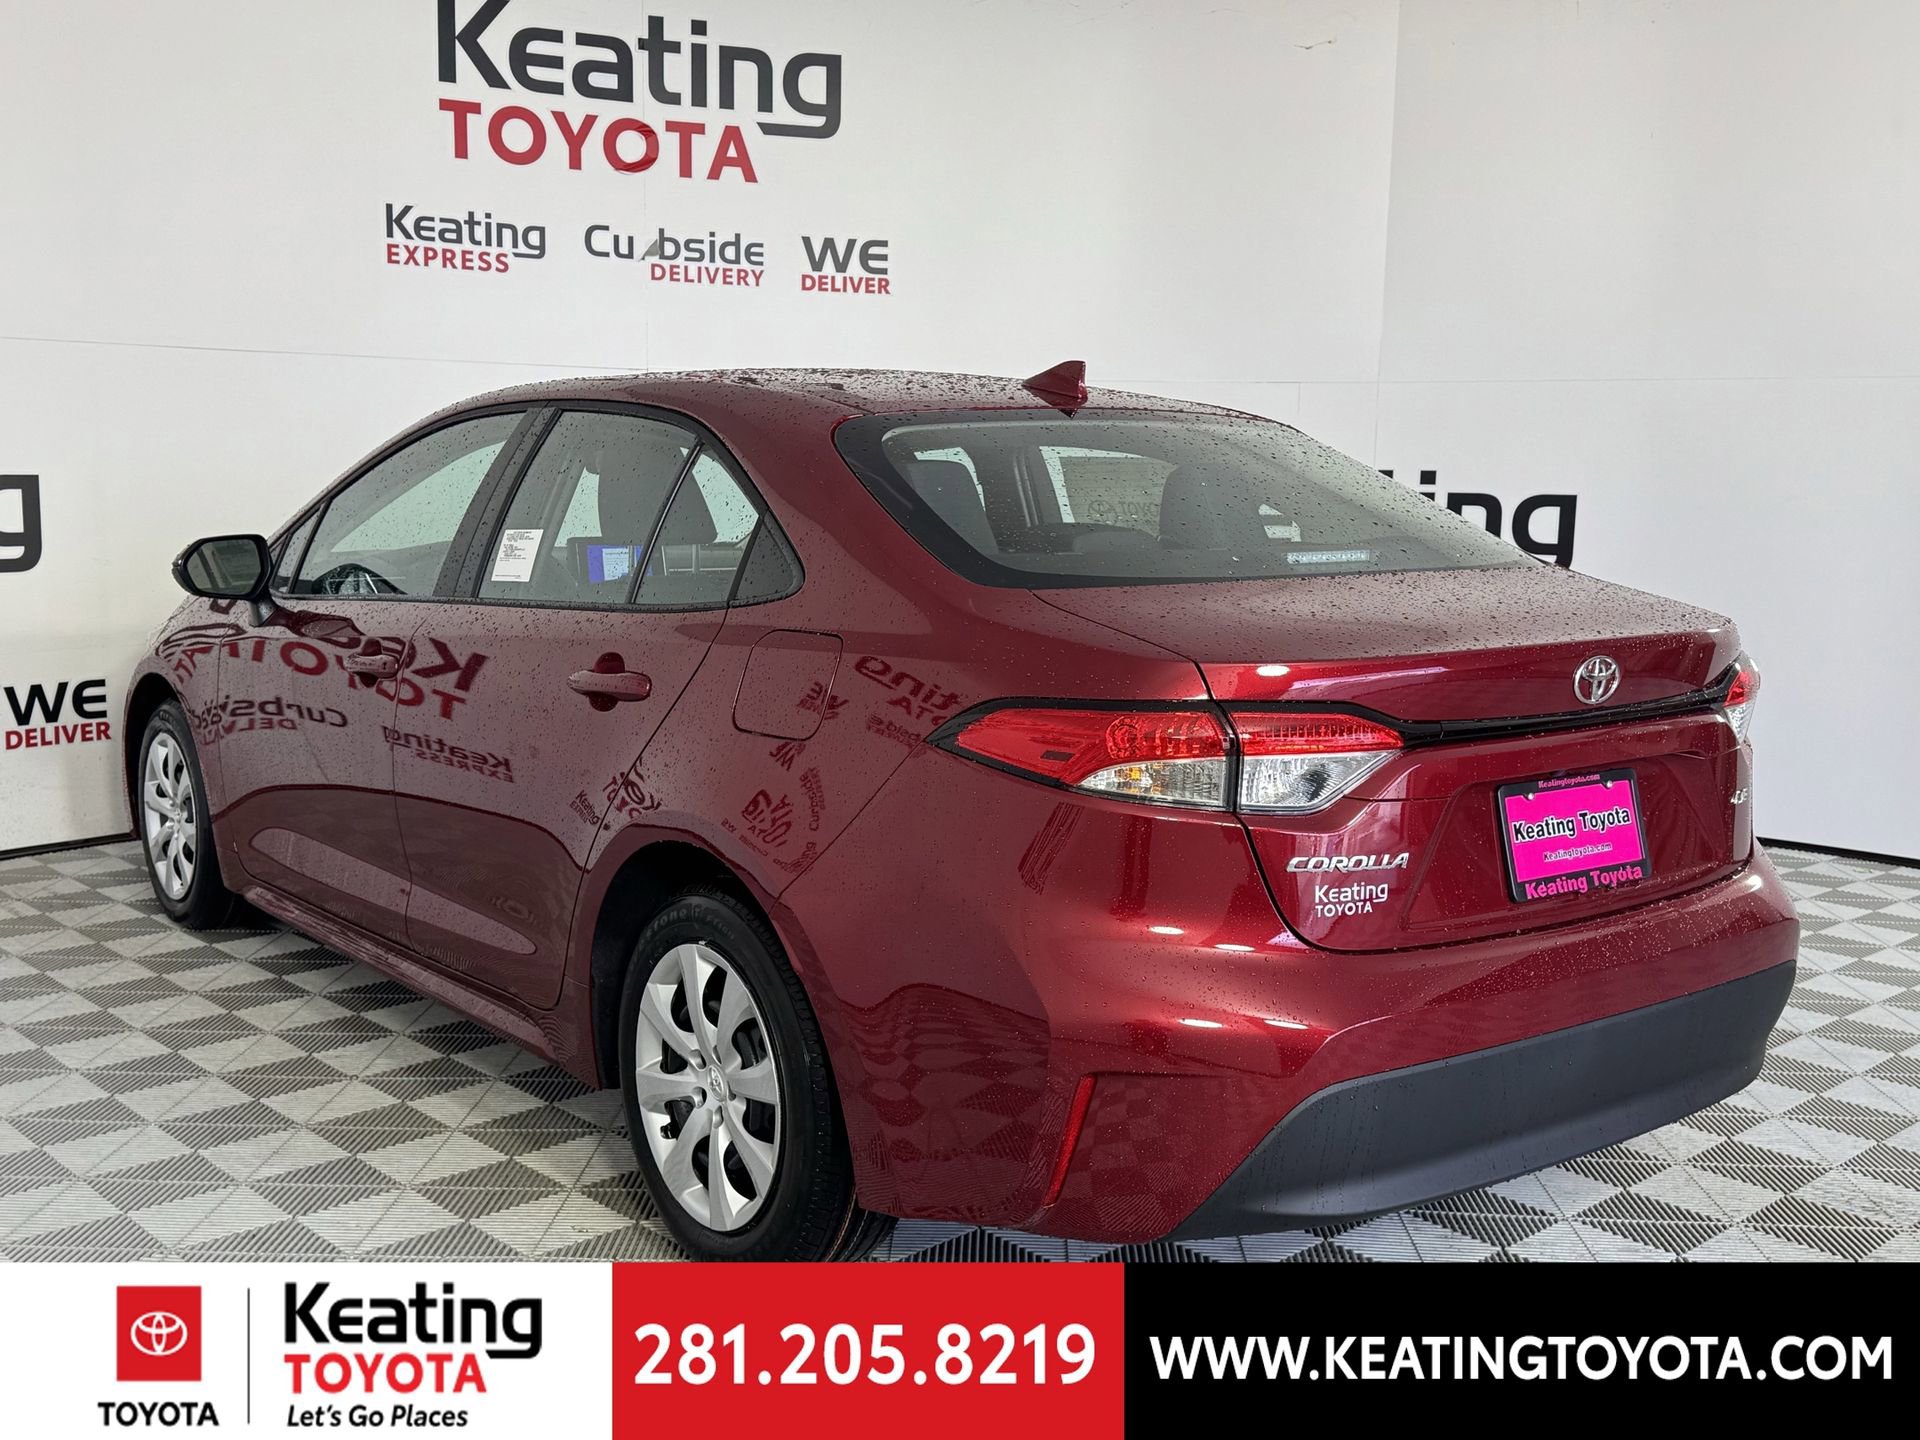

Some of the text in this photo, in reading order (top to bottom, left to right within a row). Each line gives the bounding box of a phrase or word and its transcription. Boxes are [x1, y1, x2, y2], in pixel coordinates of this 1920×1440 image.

[437, 0, 842, 139] Keating
[438, 98, 758, 183] TOYOTA
[385, 203, 546, 260] Keating
[584, 224, 764, 267] Cubside
[386, 244, 509, 273] EXPRESS
[801, 235, 889, 275] WE
[650, 263, 764, 287] DELIVERY
[801, 273, 891, 295] DELIVER
[4, 679, 107, 727] WE
[5, 721, 111, 750] DELIVER
[1538, 773, 1601, 789] Keatingtoyota.com
[1513, 806, 1631, 842] Keating Toyota
[1286, 852, 1410, 873] COROLLA
[1543, 842, 1613, 862] Keatingtoyota.com
[1315, 881, 1389, 903] Keating
[1525, 865, 1643, 899] Keating Toyota
[1315, 902, 1373, 918] TOYOTA
